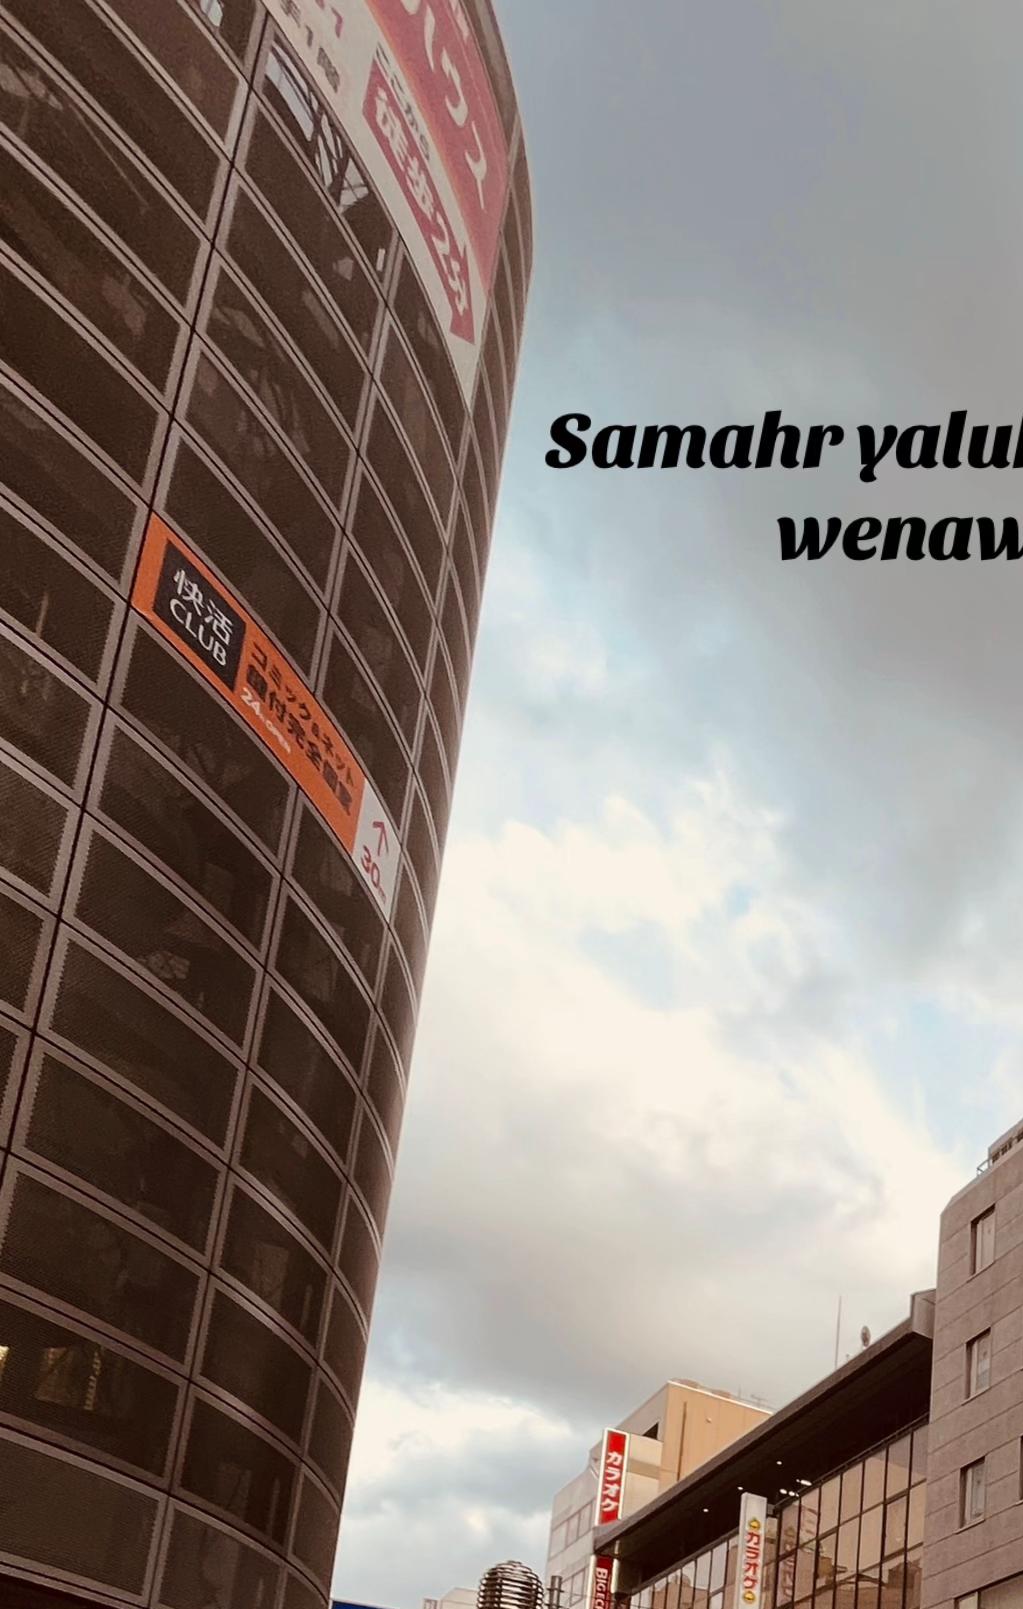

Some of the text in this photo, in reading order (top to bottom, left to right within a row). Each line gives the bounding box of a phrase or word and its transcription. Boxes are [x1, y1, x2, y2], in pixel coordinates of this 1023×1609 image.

[169, 598, 227, 667] CLUB
[174, 569, 233, 644] 快活
[602, 1451, 622, 1512] カラオケ
[595, 1566, 608, 1590] BIG
